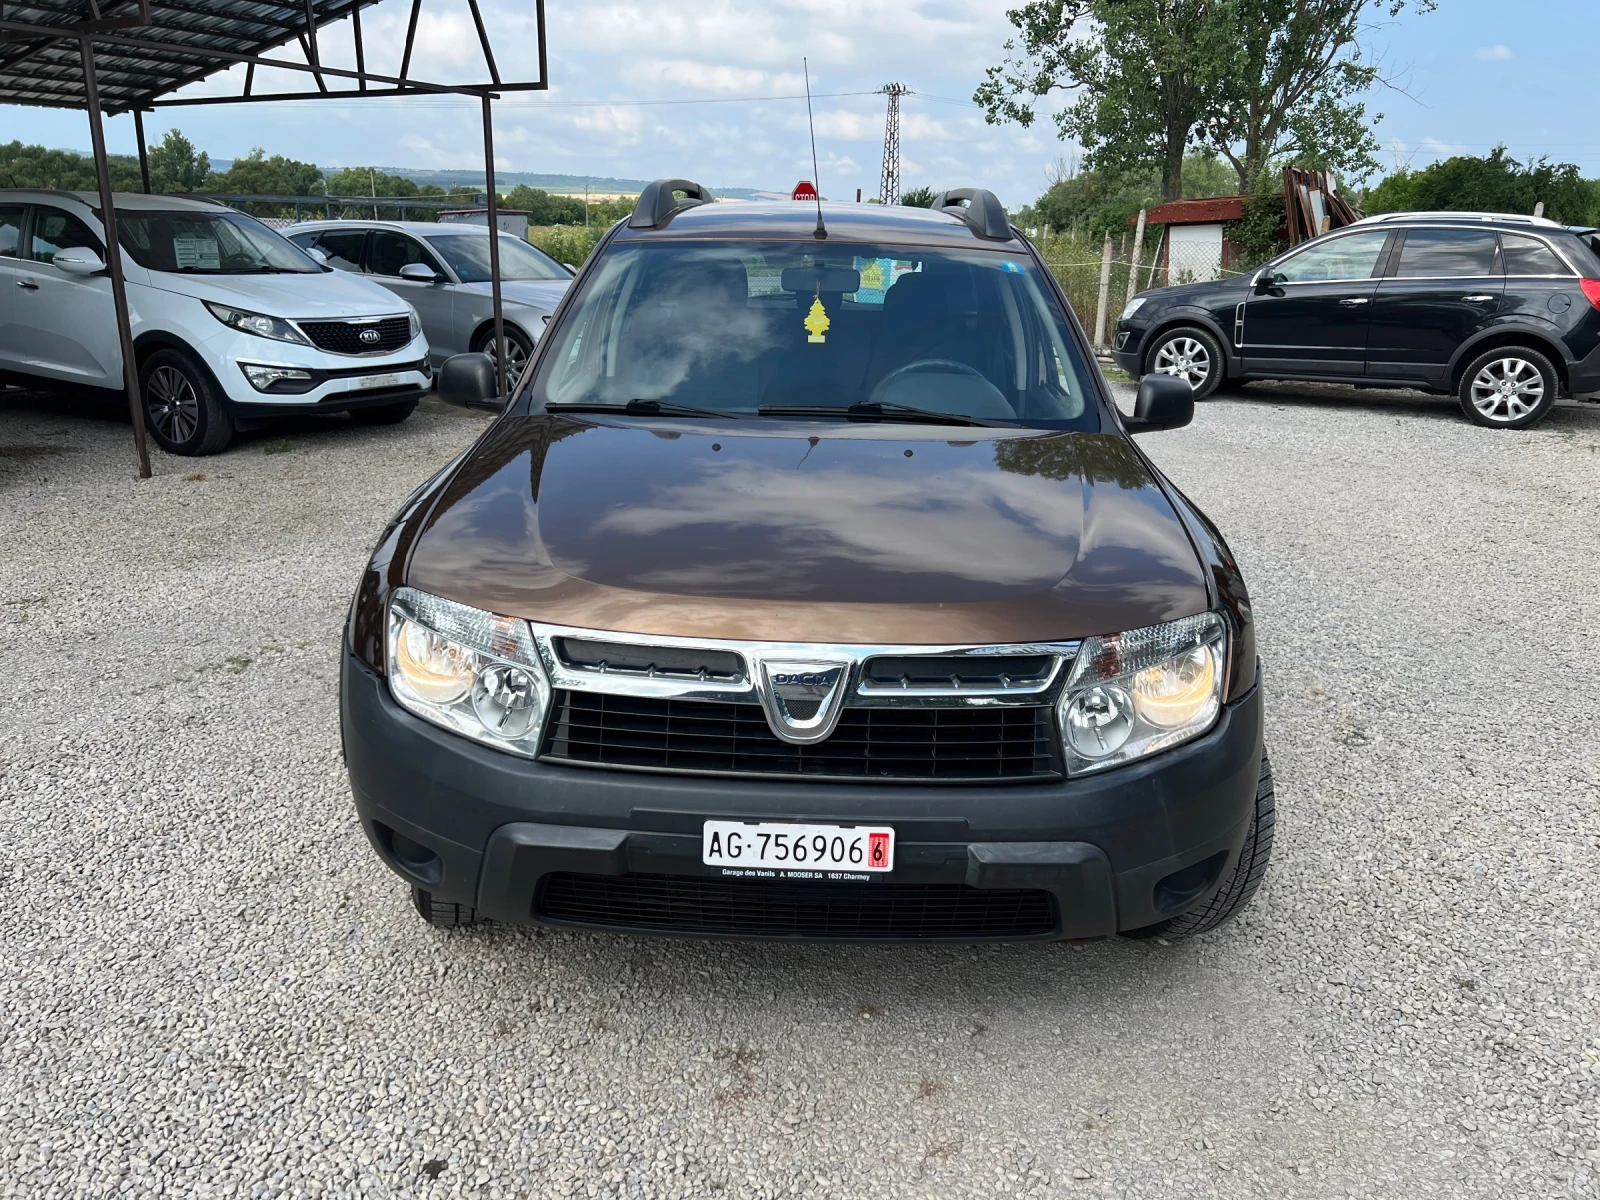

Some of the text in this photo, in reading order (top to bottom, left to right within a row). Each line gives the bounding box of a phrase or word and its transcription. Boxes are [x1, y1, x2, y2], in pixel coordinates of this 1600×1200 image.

[363, 332, 379, 341] KIA
[775, 673, 831, 686] DACIA
[722, 868, 743, 877] Garage
[843, 873, 870, 881] Charmey
